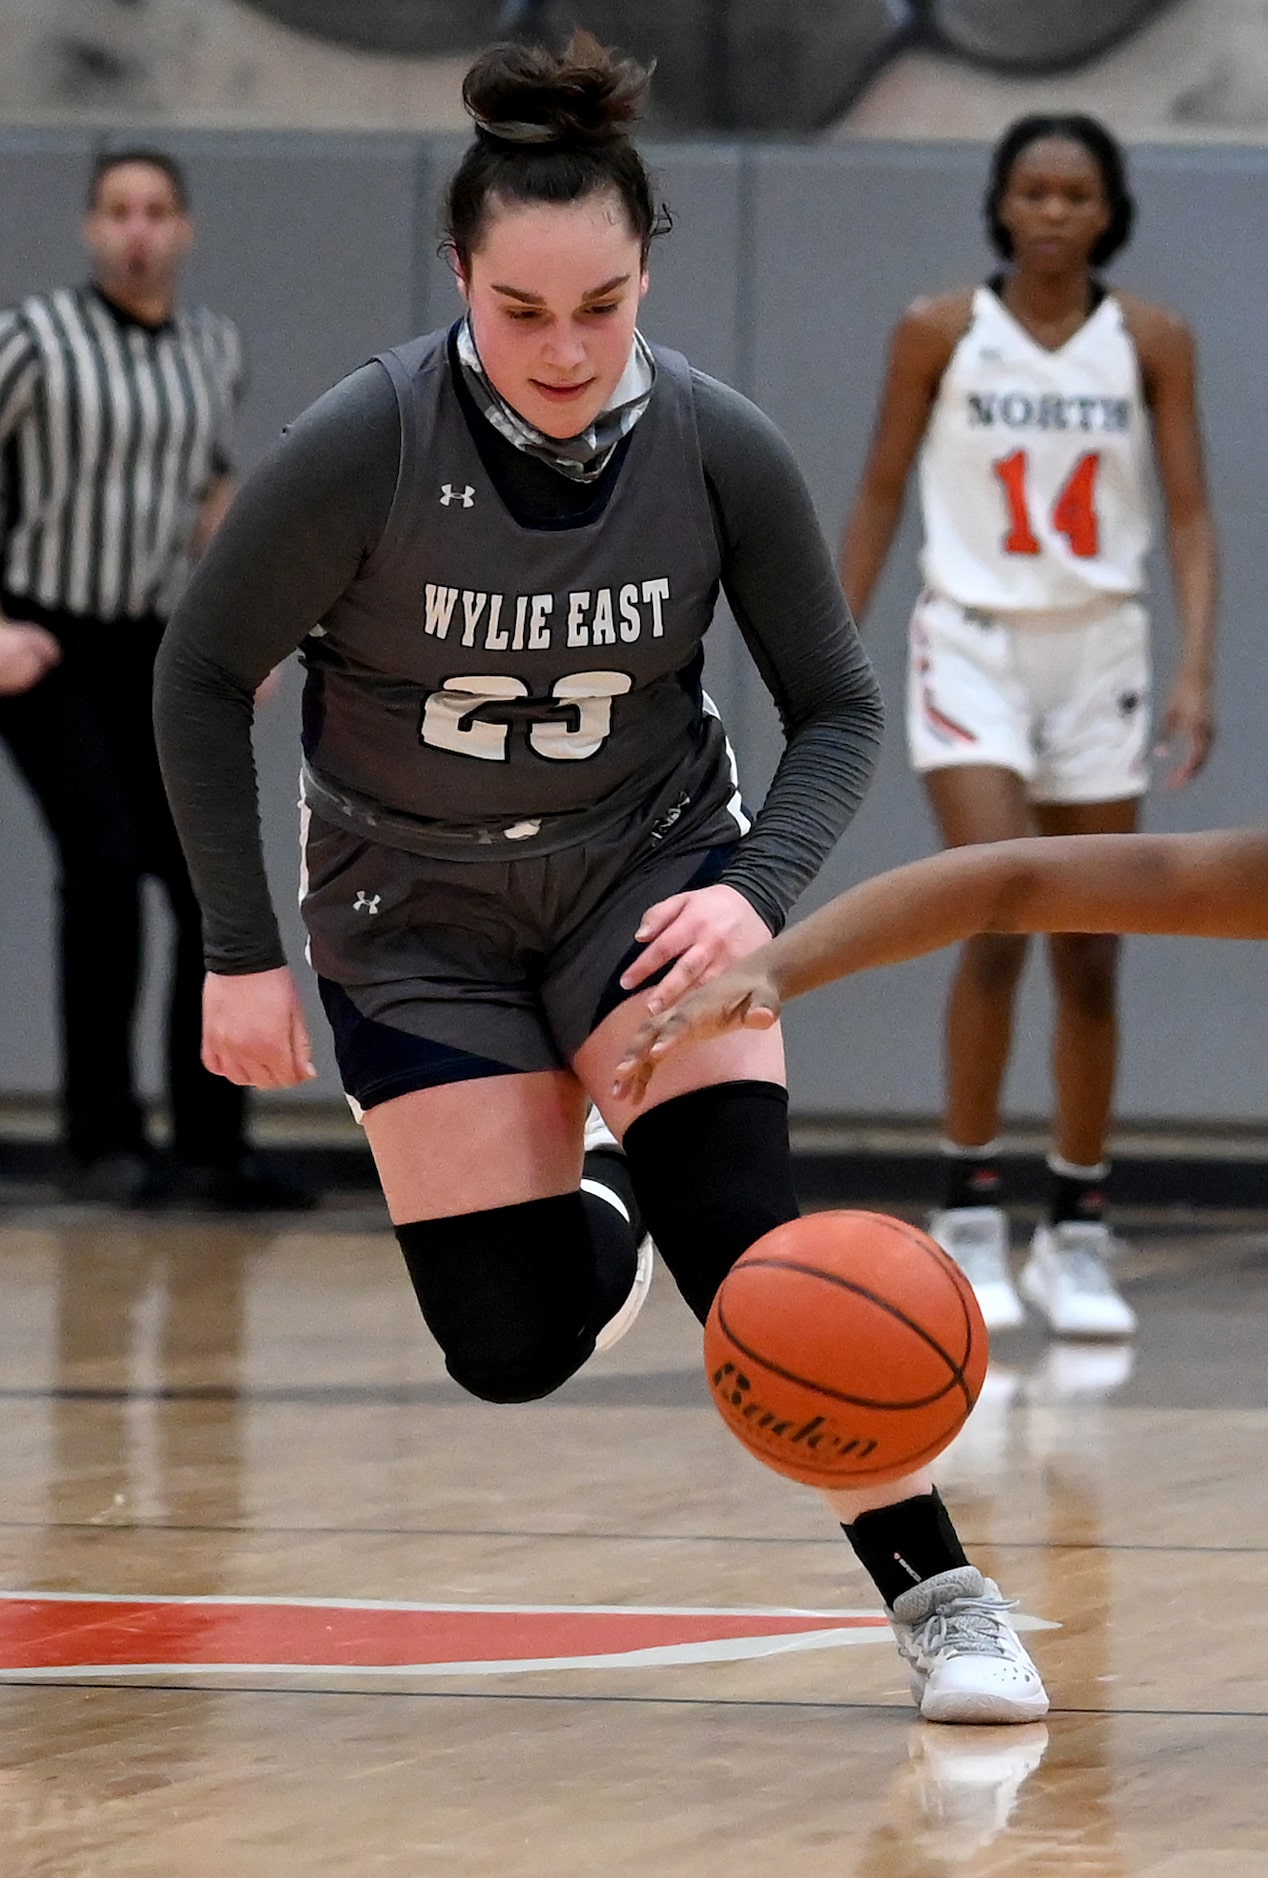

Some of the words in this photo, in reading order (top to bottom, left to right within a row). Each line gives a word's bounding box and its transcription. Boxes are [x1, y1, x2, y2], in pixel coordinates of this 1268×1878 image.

[965, 391, 1129, 433] NORTH
[993, 450, 1100, 557] 14
[422, 581, 554, 651] WYLIE
[565, 576, 671, 648] EAST
[418, 669, 636, 764] 23
